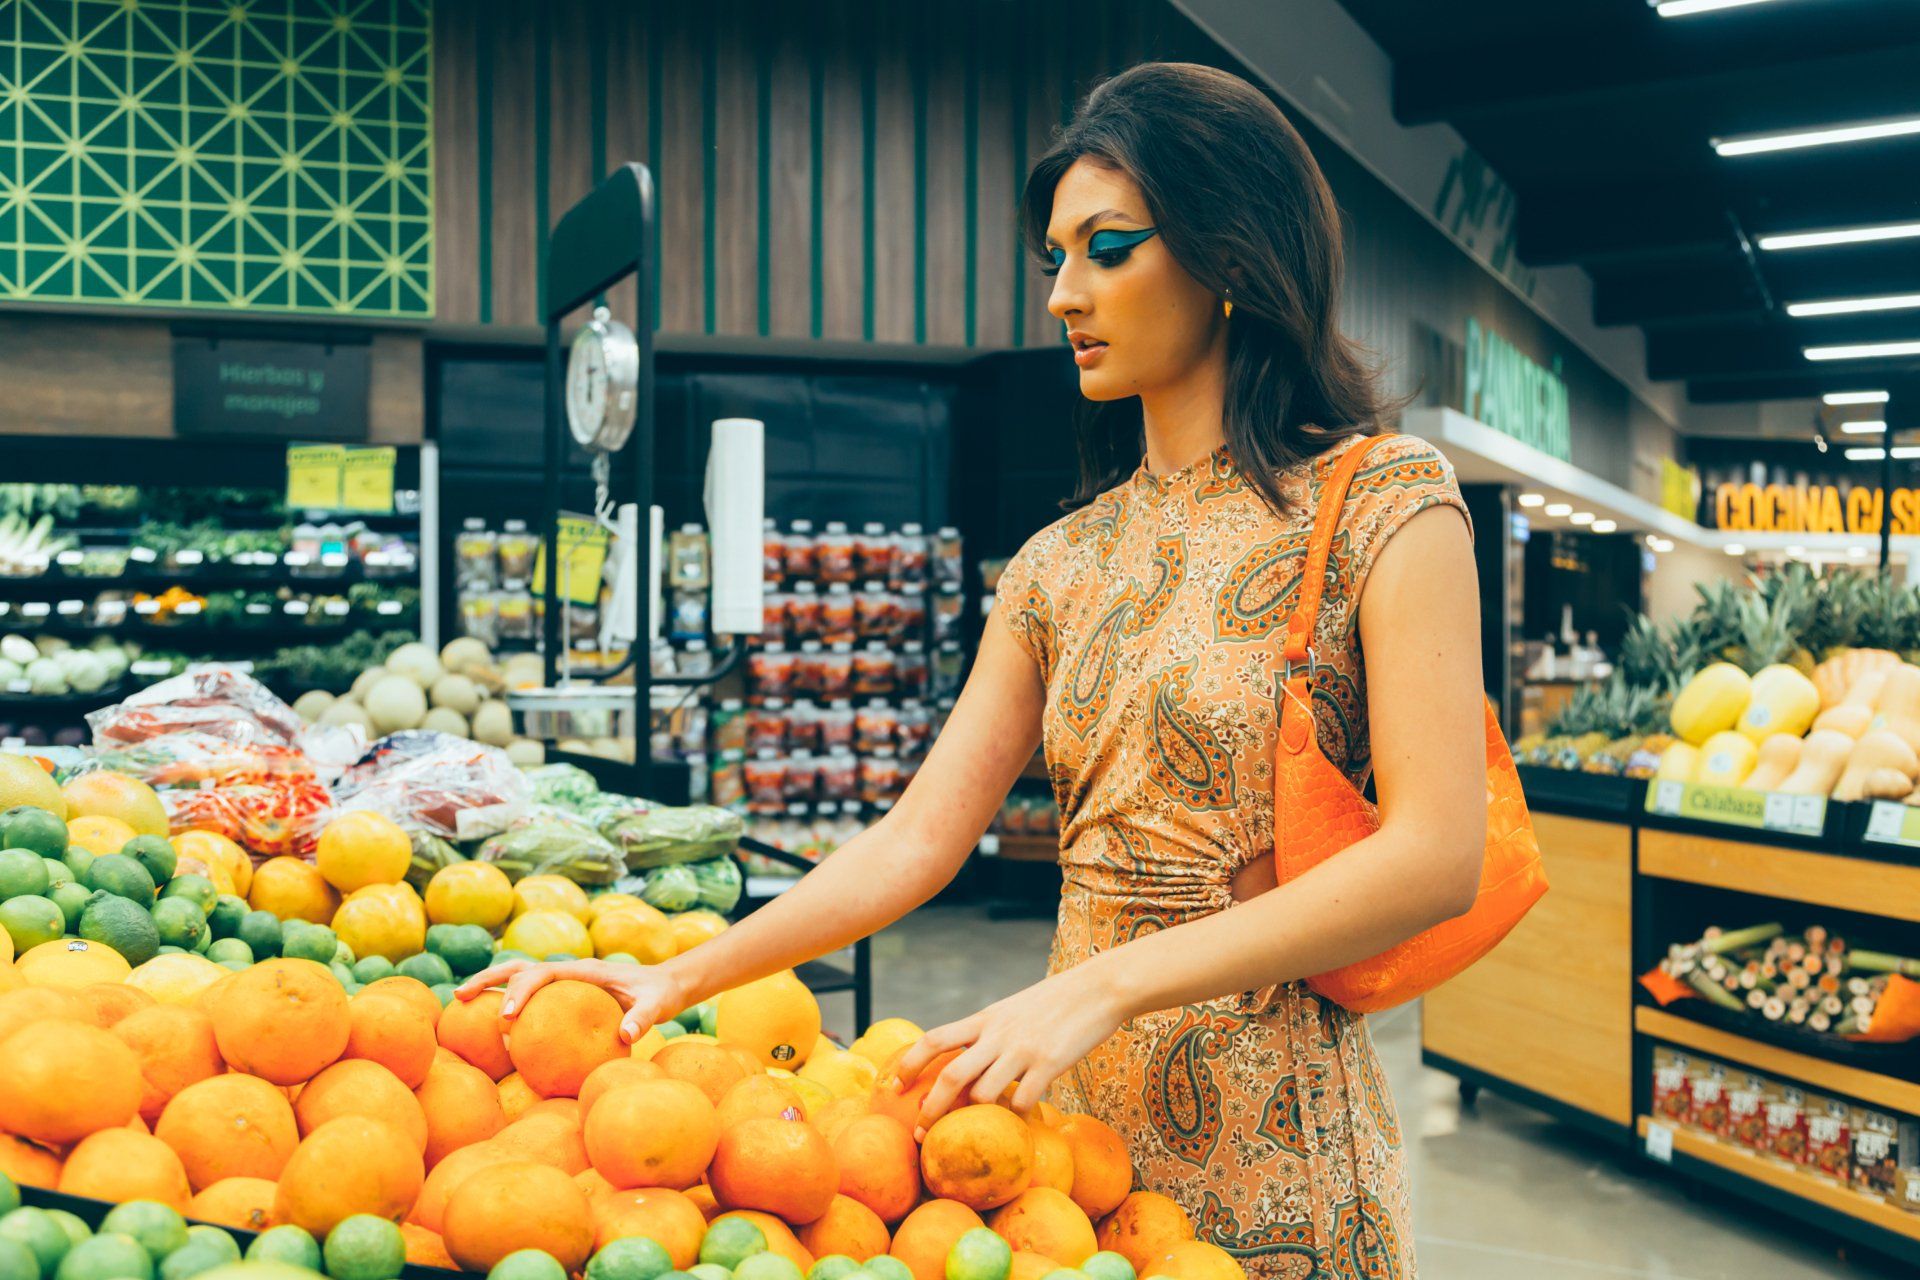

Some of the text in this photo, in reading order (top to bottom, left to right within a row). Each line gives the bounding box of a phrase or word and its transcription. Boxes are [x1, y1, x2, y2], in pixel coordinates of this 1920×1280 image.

[219, 362, 324, 392] Hierbas y
[1716, 482, 1845, 532] COCINA
[1690, 791, 1764, 819] Calabaza
